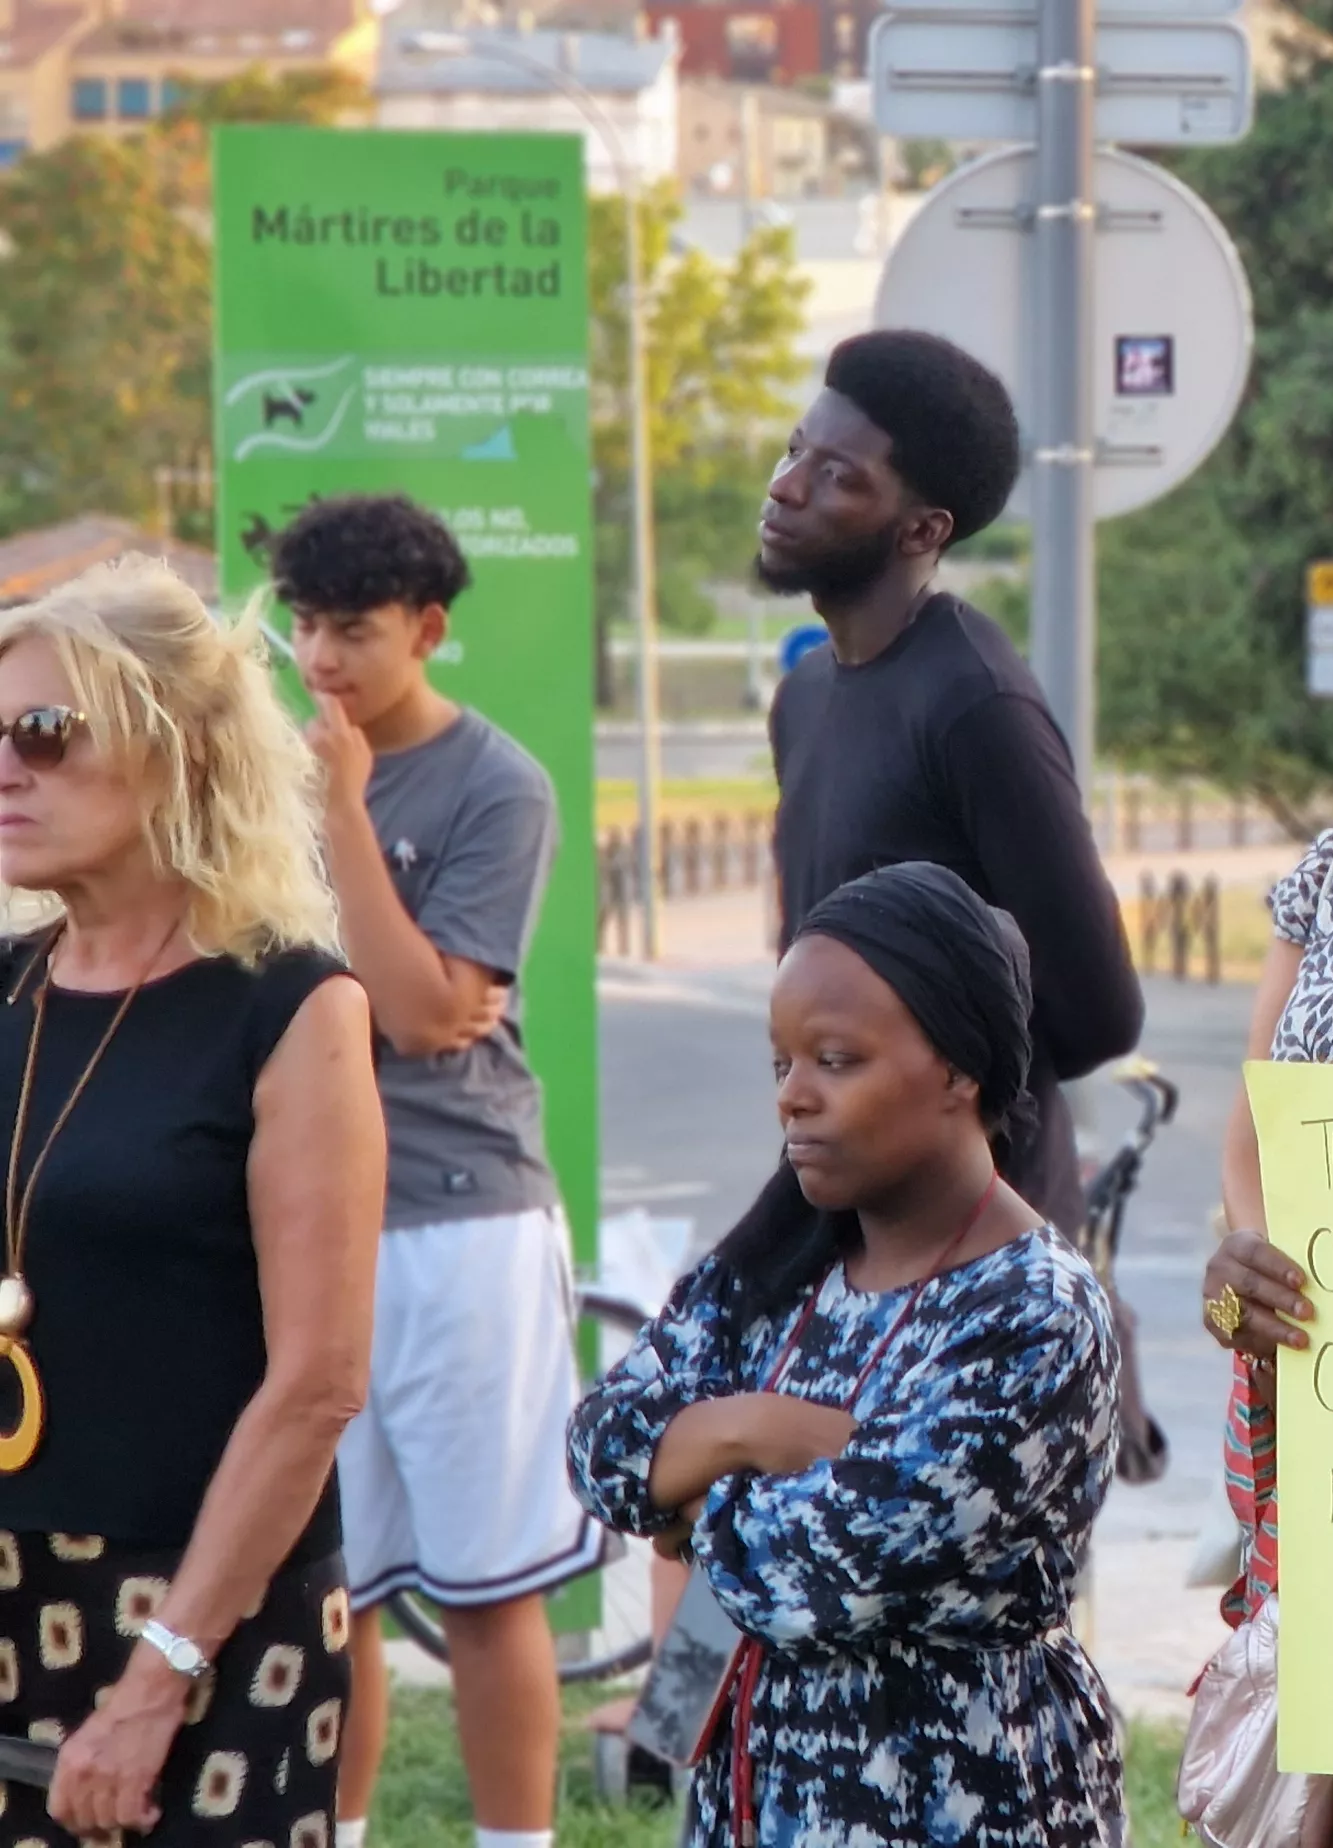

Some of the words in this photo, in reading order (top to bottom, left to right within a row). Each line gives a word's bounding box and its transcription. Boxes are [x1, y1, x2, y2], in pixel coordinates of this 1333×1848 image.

[443, 167, 561, 205] Parque
[252, 203, 443, 248] Mártires
[455, 207, 507, 248] de
[520, 209, 561, 249] la
[375, 257, 561, 298] Libertad
[362, 366, 453, 388] SIEMPRE
[457, 366, 501, 388] CON
[505, 366, 586, 390] CORREA
[382, 393, 504, 415] SOLAMENTE
